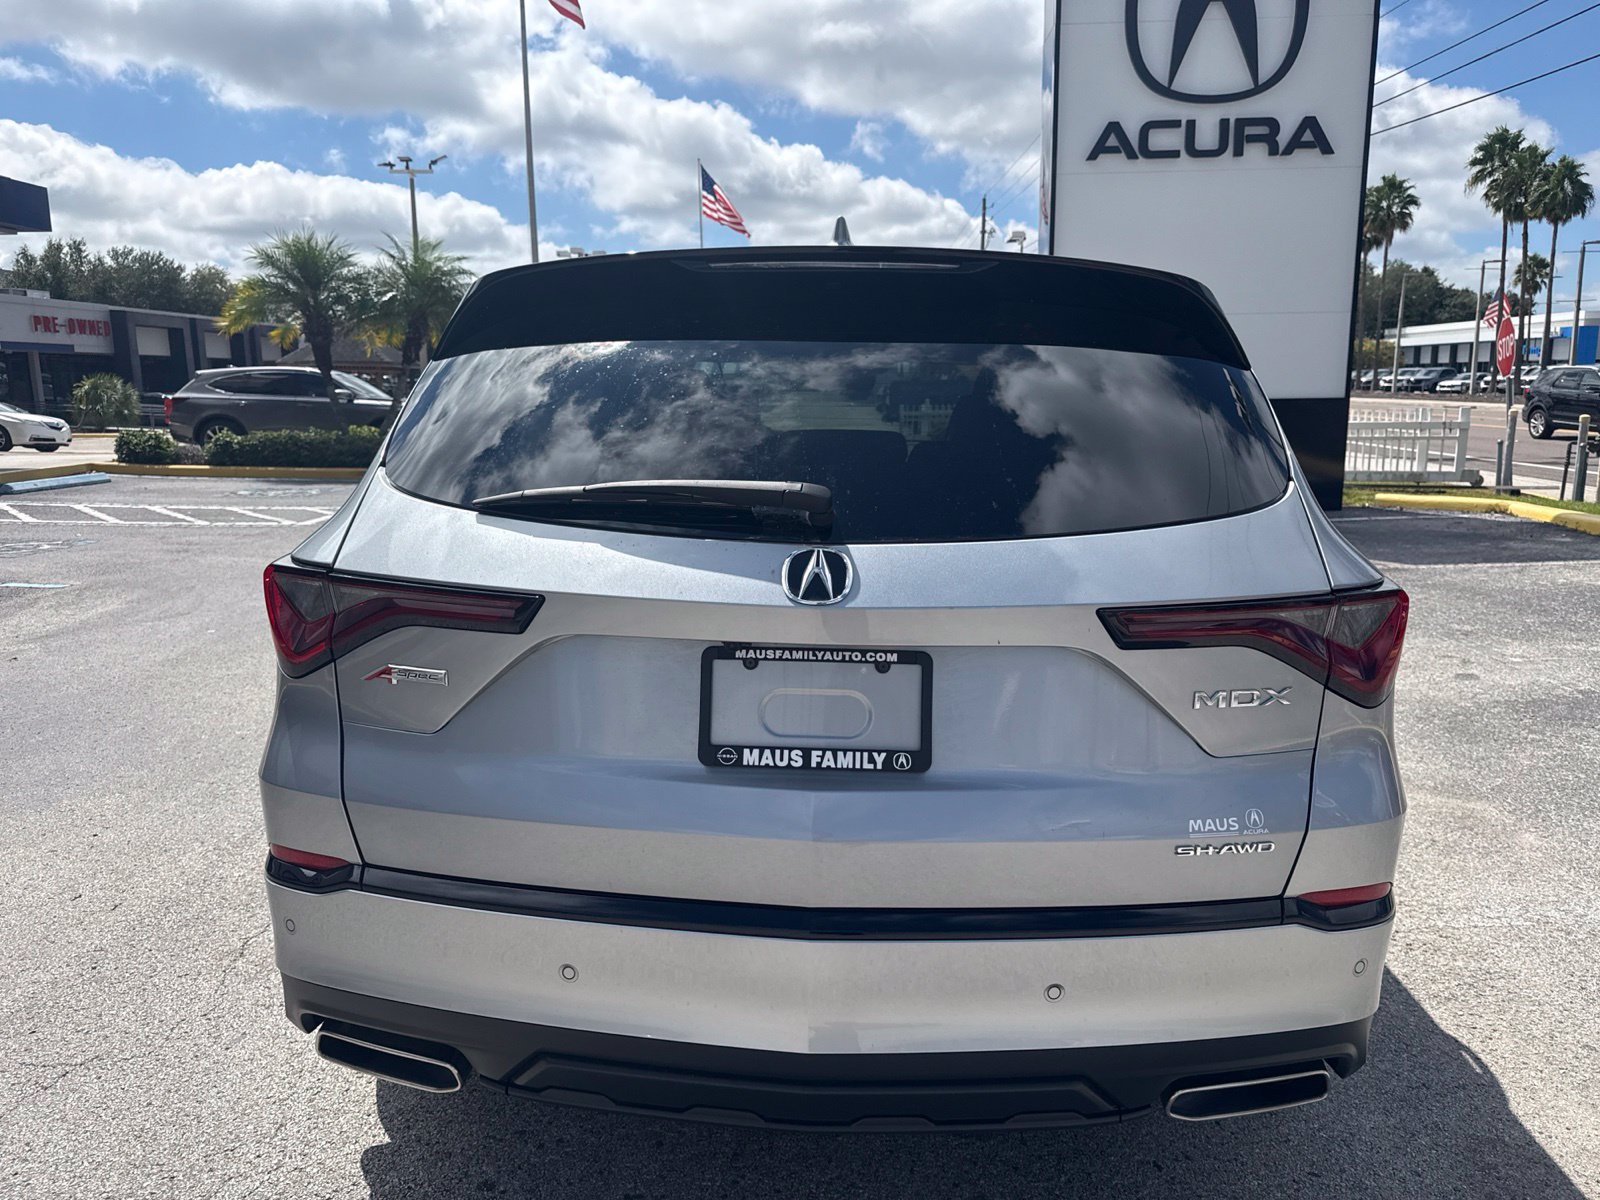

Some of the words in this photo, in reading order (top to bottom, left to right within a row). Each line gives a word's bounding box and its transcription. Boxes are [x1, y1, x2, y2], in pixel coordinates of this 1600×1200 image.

[1086, 115, 1335, 161] ACURA
[32, 315, 111, 337] PRE-OWNED
[1498, 333, 1514, 361] STOP
[735, 649, 898, 662] MAUSFAMILYAUTO.COM
[1193, 686, 1293, 710] MDX
[742, 748, 803, 767] MAUS
[810, 750, 887, 770] FAMILY
[1189, 817, 1239, 832] MAUS
[1175, 841, 1276, 857] SH-AWD
